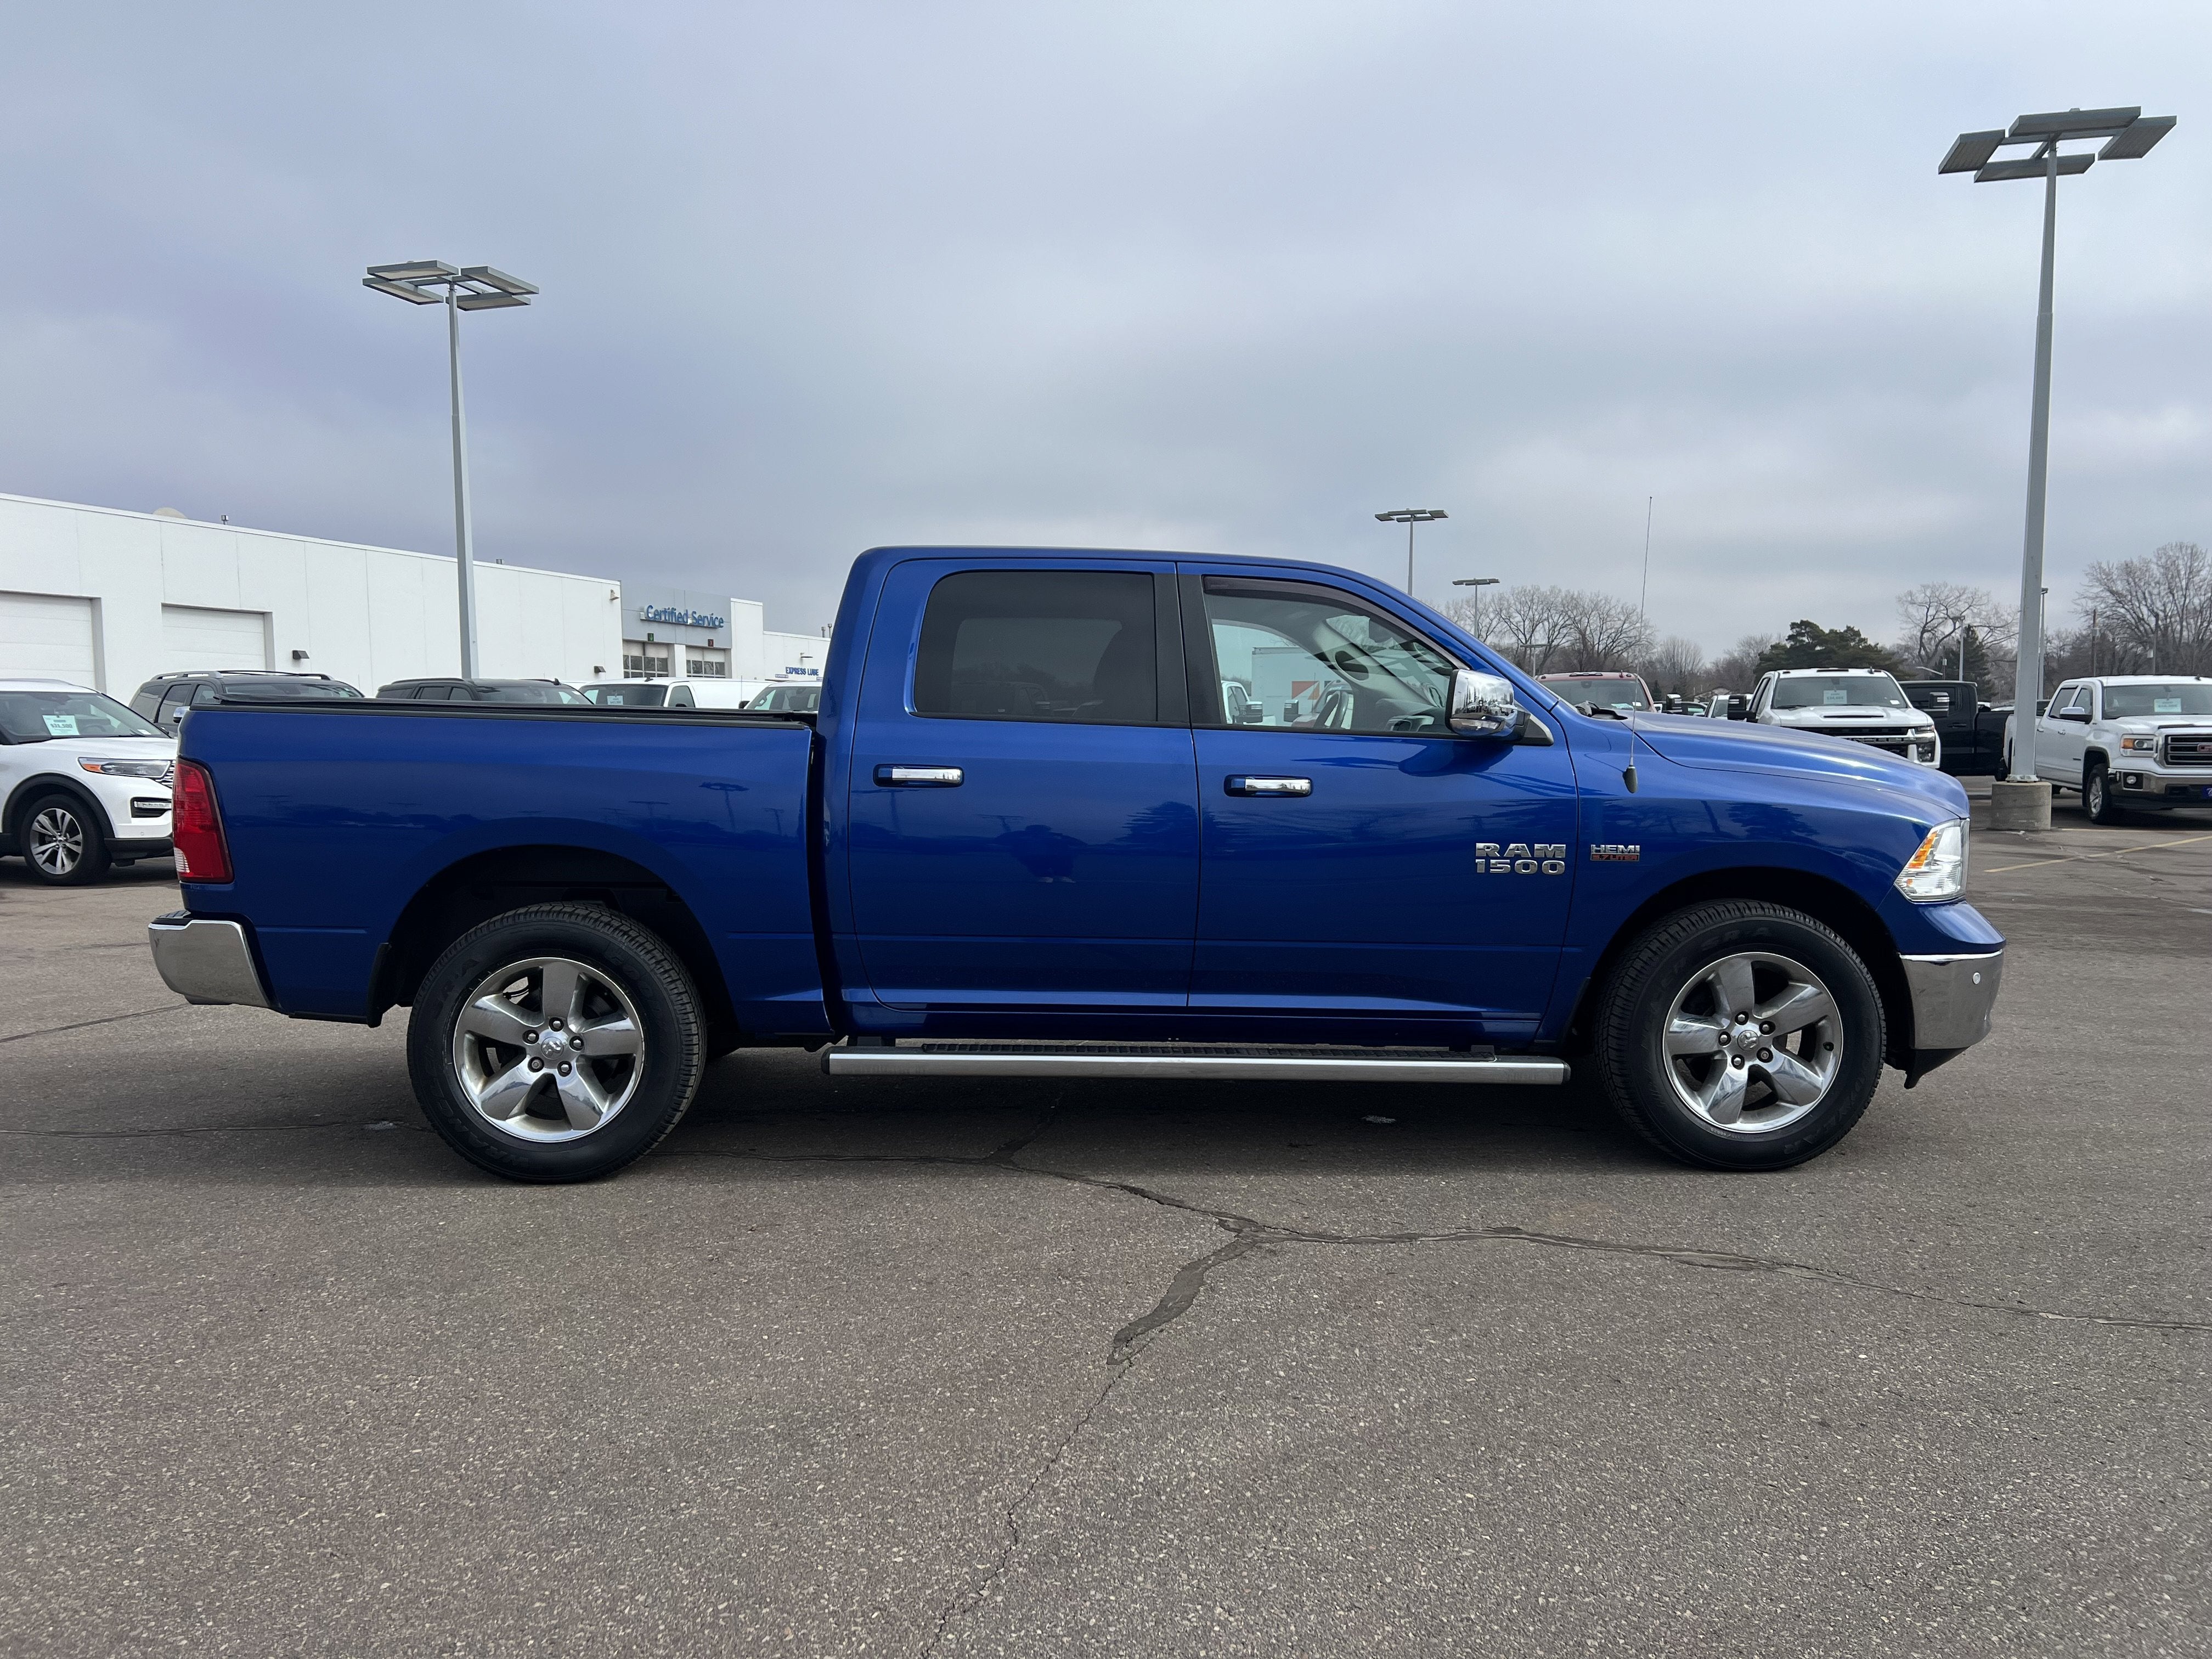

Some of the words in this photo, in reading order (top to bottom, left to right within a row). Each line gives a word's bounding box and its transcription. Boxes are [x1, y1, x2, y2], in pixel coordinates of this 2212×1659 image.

[646, 605, 688, 624] Certified
[691, 611, 724, 628] Service
[785, 666, 806, 675] EXPRESS
[1475, 843, 1566, 858] RAM
[1590, 844, 1640, 854] HEMI
[1475, 859, 1565, 875] 1500
